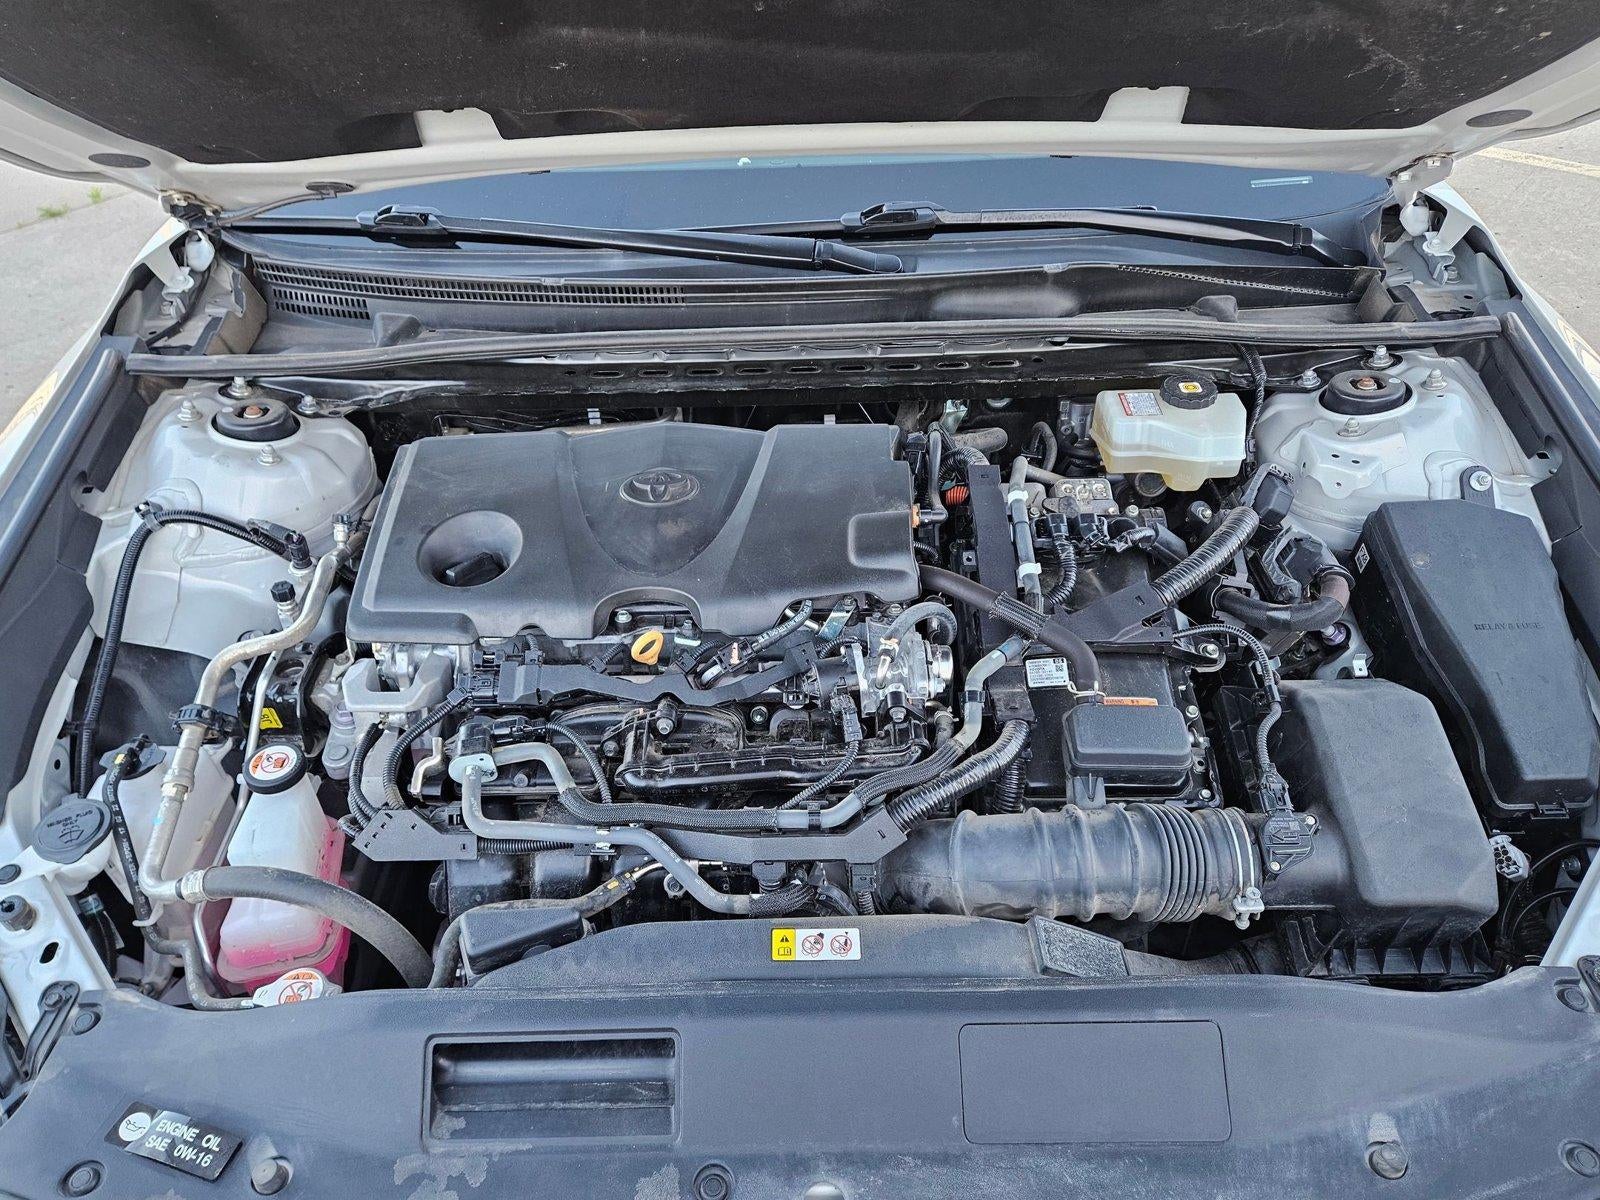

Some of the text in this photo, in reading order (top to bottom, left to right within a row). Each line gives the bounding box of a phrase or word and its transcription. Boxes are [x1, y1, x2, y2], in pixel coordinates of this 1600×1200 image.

[1474, 623, 1507, 631] RELAY
[145, 1135, 213, 1167] SAE 0W-16
[156, 1120, 222, 1152] ENGINE OIL
